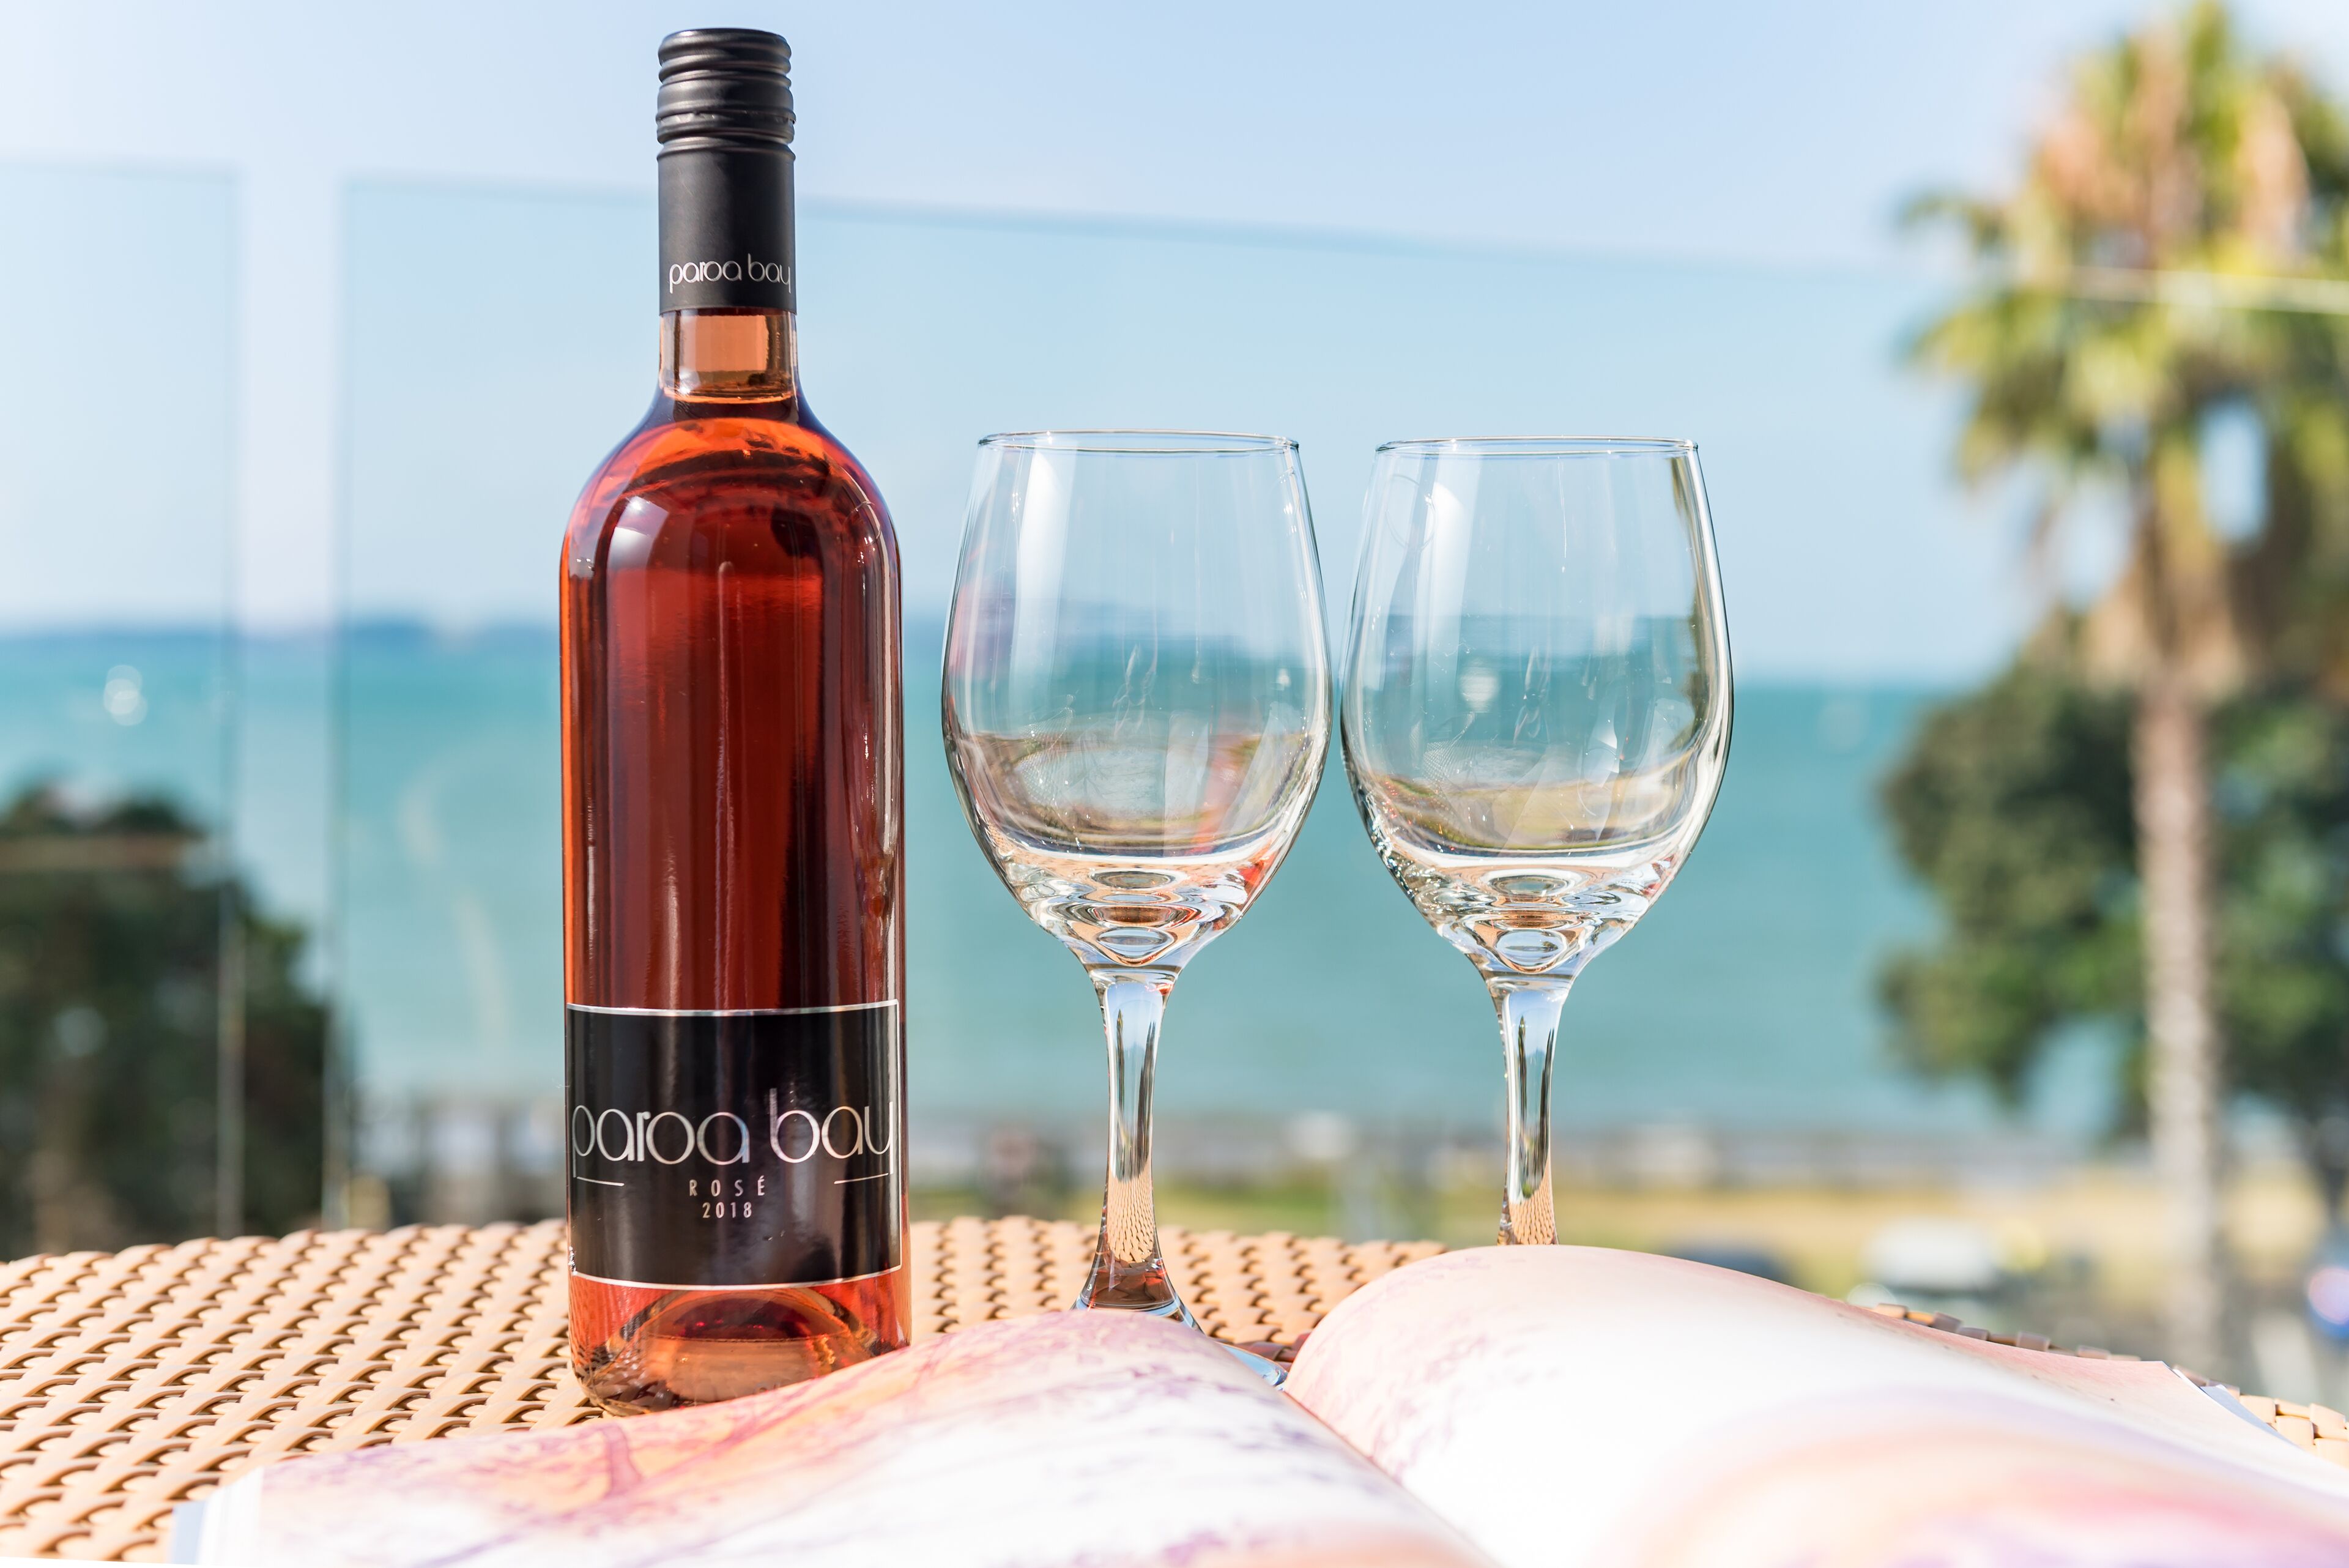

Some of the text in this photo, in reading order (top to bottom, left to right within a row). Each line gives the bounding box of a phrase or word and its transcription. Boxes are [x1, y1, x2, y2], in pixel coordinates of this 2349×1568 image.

[669, 253, 791, 294] paroa bay
[572, 1088, 894, 1178] paroa bay
[689, 1175, 765, 1197] ROSÉ
[702, 1202, 752, 1219] 2018
